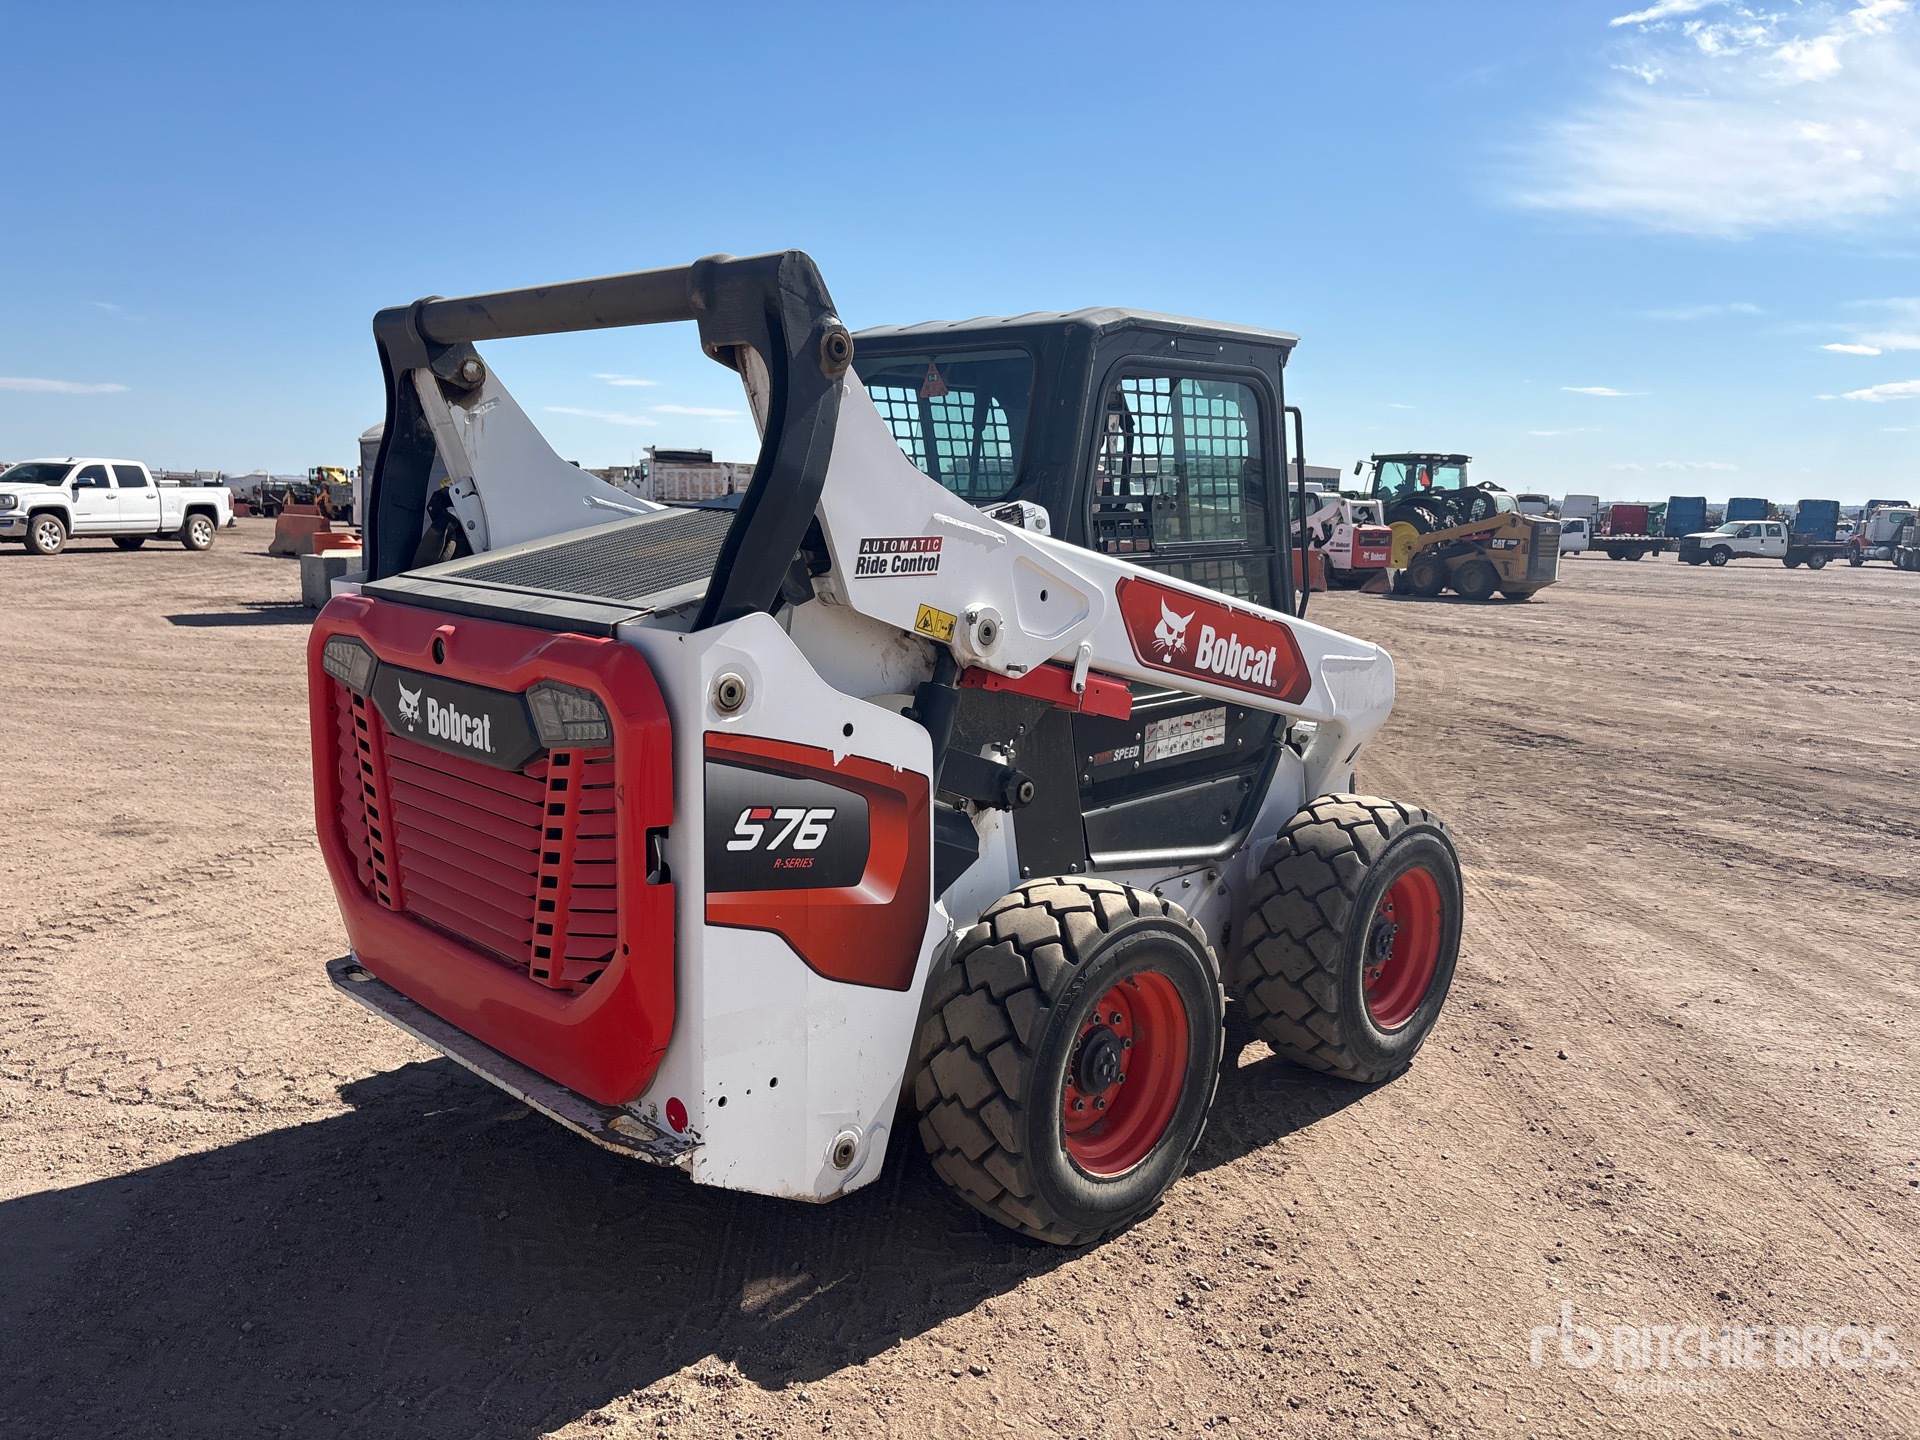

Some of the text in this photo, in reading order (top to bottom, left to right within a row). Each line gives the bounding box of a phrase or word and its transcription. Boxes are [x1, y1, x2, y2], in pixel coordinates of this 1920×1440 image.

[862, 539, 940, 553] AUTOMATIC
[1492, 538, 1506, 549] CAT
[855, 553, 941, 575] Ride Control
[1370, 552, 1387, 561] Bobcat
[1195, 624, 1277, 687] Bobcat
[426, 696, 491, 753] Bobcat
[1113, 745, 1140, 762] SPEED
[726, 807, 836, 852] S76
[773, 857, 815, 869] R-SERIES
